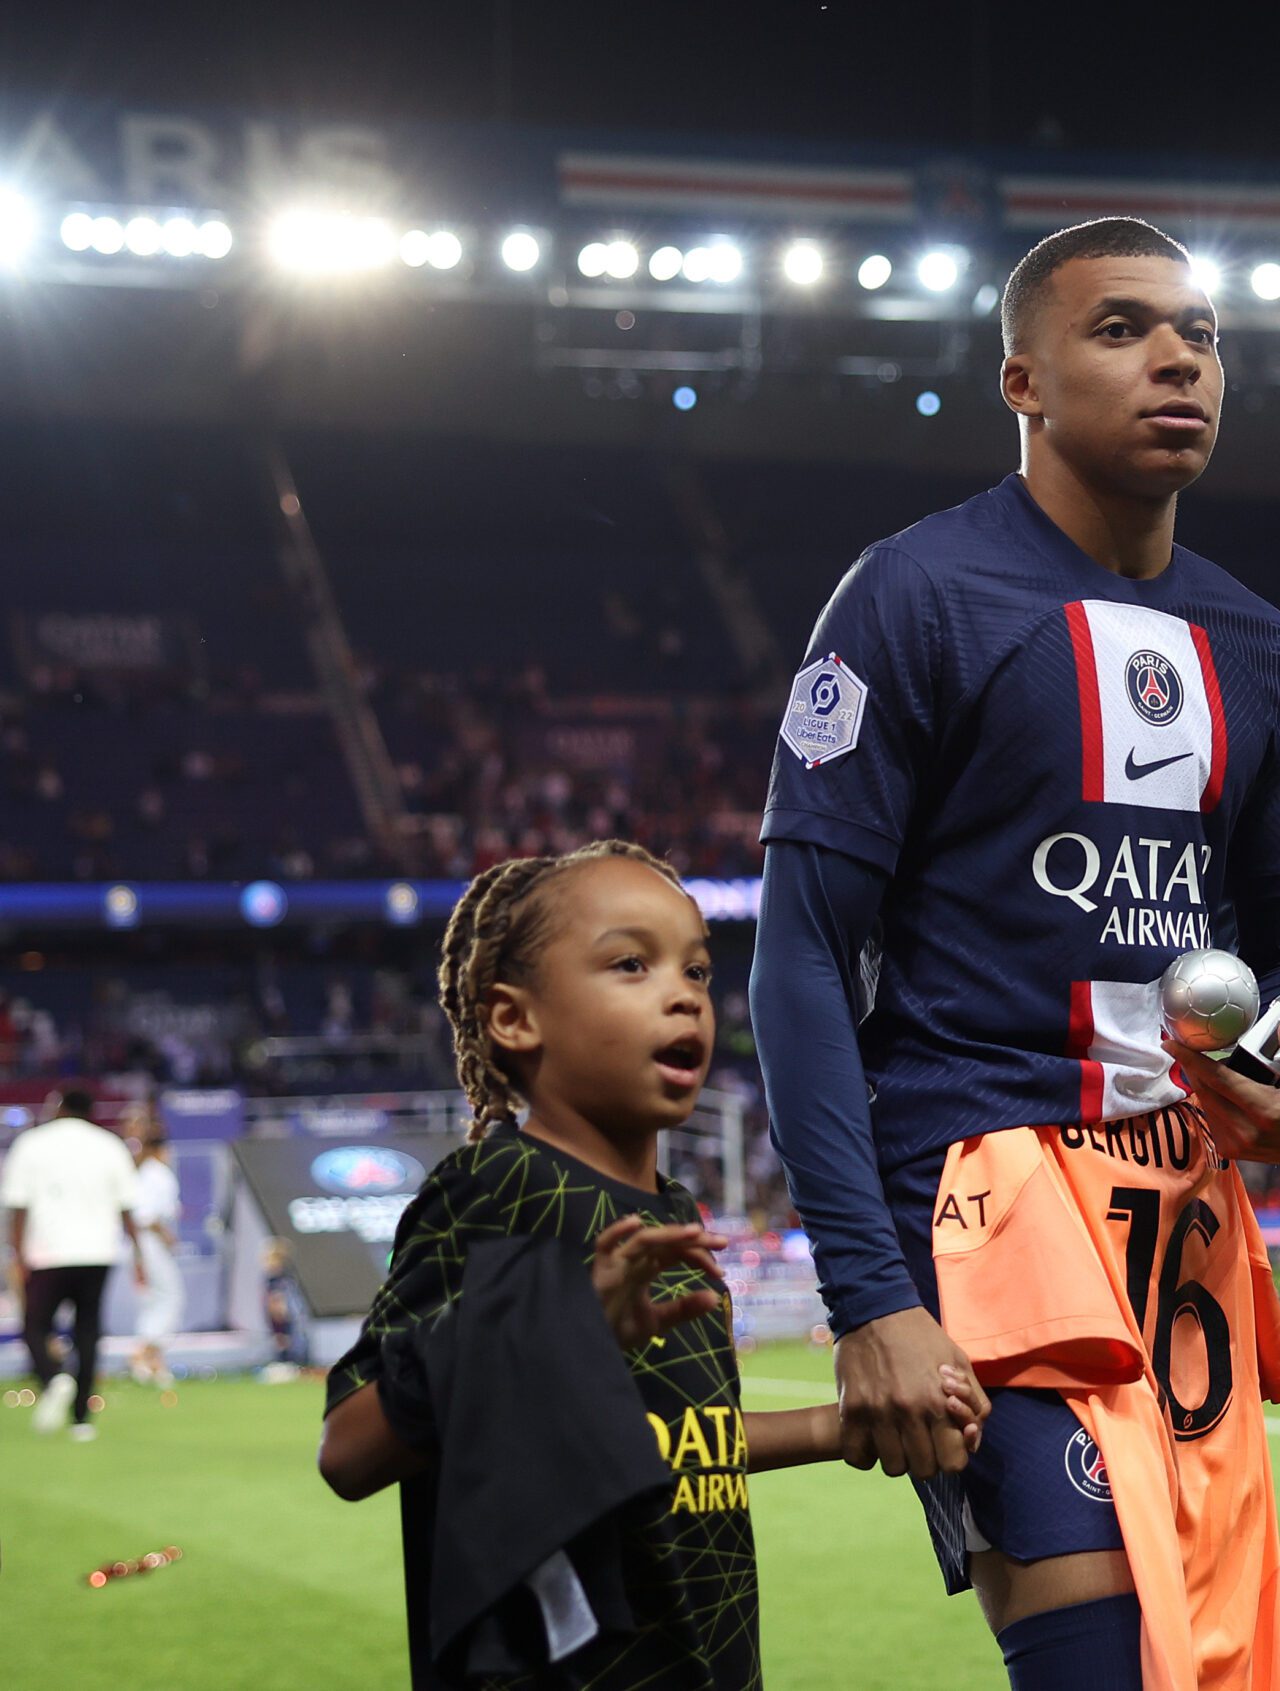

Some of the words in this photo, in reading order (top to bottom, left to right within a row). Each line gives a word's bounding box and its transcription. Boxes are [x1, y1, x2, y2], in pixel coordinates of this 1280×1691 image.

[0, 110, 402, 204] ARIS
[1132, 655, 1168, 674] PARIS
[803, 718, 829, 730] LIGUE
[831, 723, 836, 731] 1
[817, 732, 836, 743] Eats
[1100, 906, 1211, 949] AIRWAY
[1106, 1186, 1233, 1441] 16
